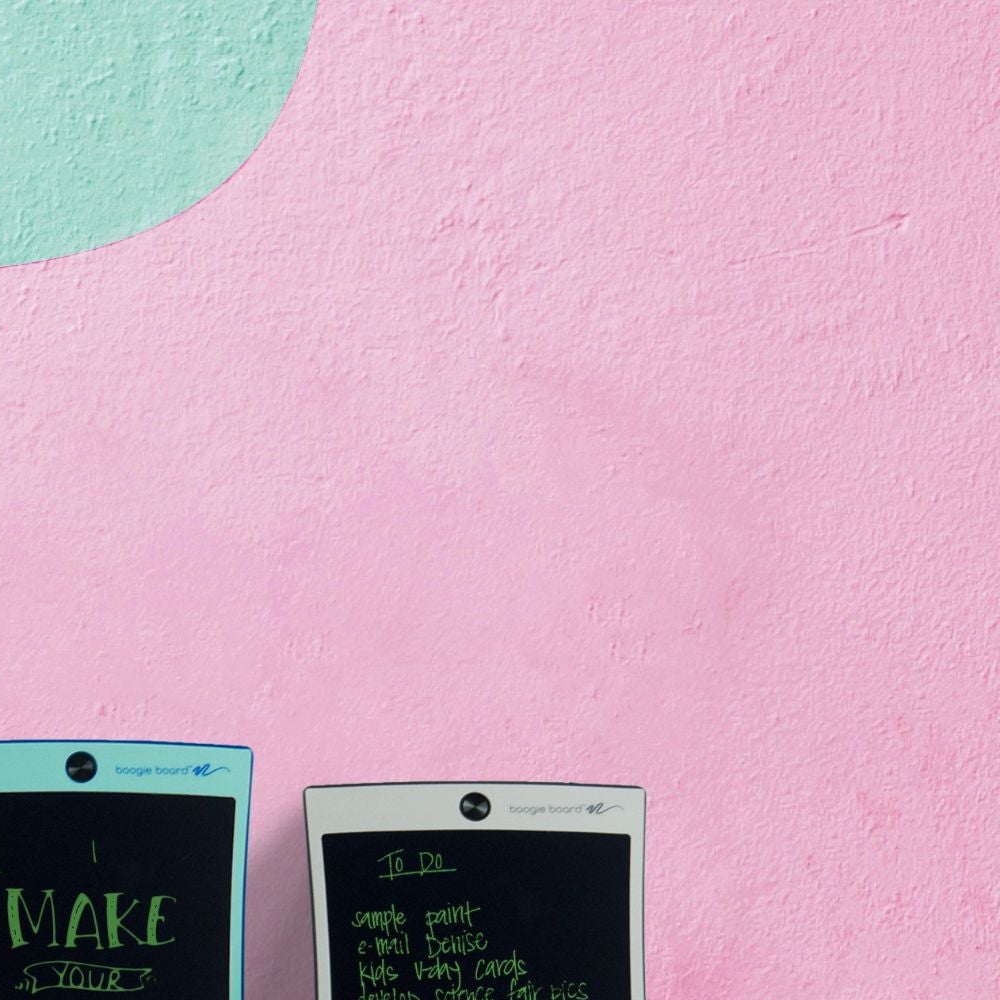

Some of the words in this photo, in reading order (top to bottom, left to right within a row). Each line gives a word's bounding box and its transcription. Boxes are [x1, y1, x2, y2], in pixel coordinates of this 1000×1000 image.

[115, 765, 153, 777] boogie
[509, 804, 546, 816] boogie
[5, 888, 177, 950] MAKE
[351, 903, 406, 937] sample
[425, 900, 481, 939] paint
[357, 930, 410, 956] e-mail
[426, 929, 488, 959] Denise
[51, 961, 126, 991] YOUR
[475, 951, 528, 980] cards
